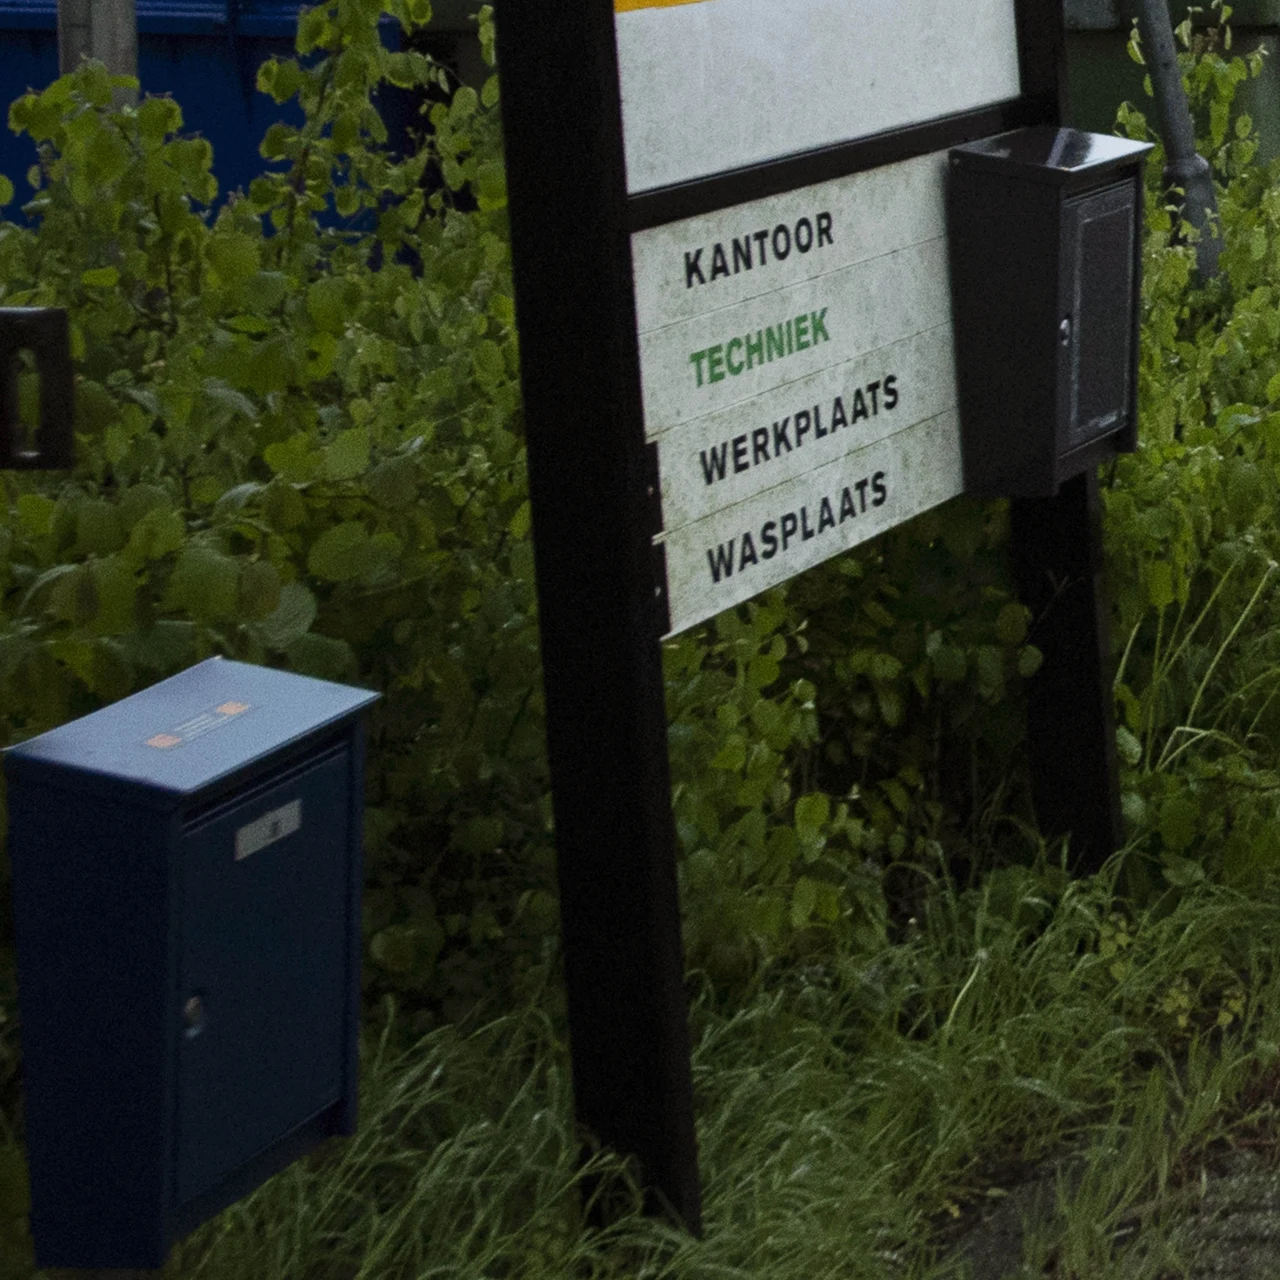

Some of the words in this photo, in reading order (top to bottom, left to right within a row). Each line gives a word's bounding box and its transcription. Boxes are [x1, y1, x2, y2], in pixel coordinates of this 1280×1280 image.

[684, 210, 835, 289] KANTOOR
[689, 306, 830, 389] TECHNIEK
[700, 373, 900, 486] WERKPLAATS
[706, 470, 888, 584] WASPLAATS
